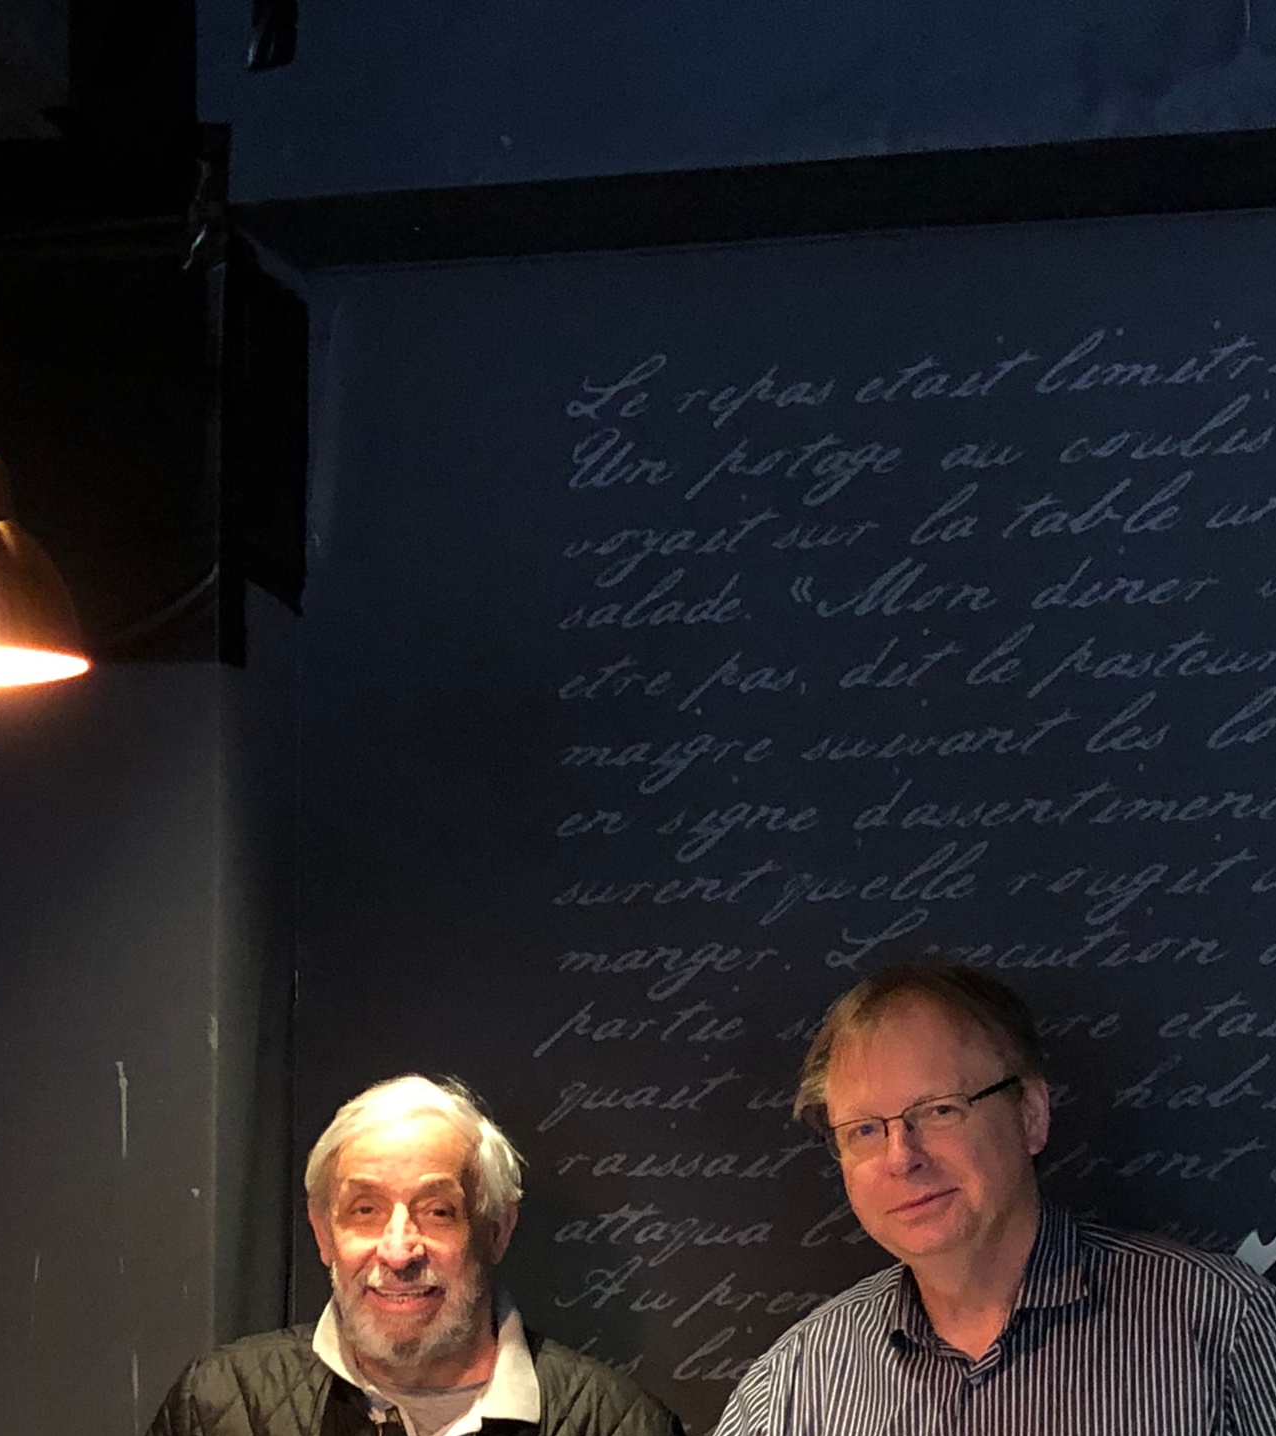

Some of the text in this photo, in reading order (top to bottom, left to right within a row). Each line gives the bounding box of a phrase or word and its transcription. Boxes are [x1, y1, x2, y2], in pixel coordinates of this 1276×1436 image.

[677, 364, 835, 428] repas
[685, 434, 902, 506] potage
[1003, 470, 1195, 538] table
[964, 624, 1035, 685] le
